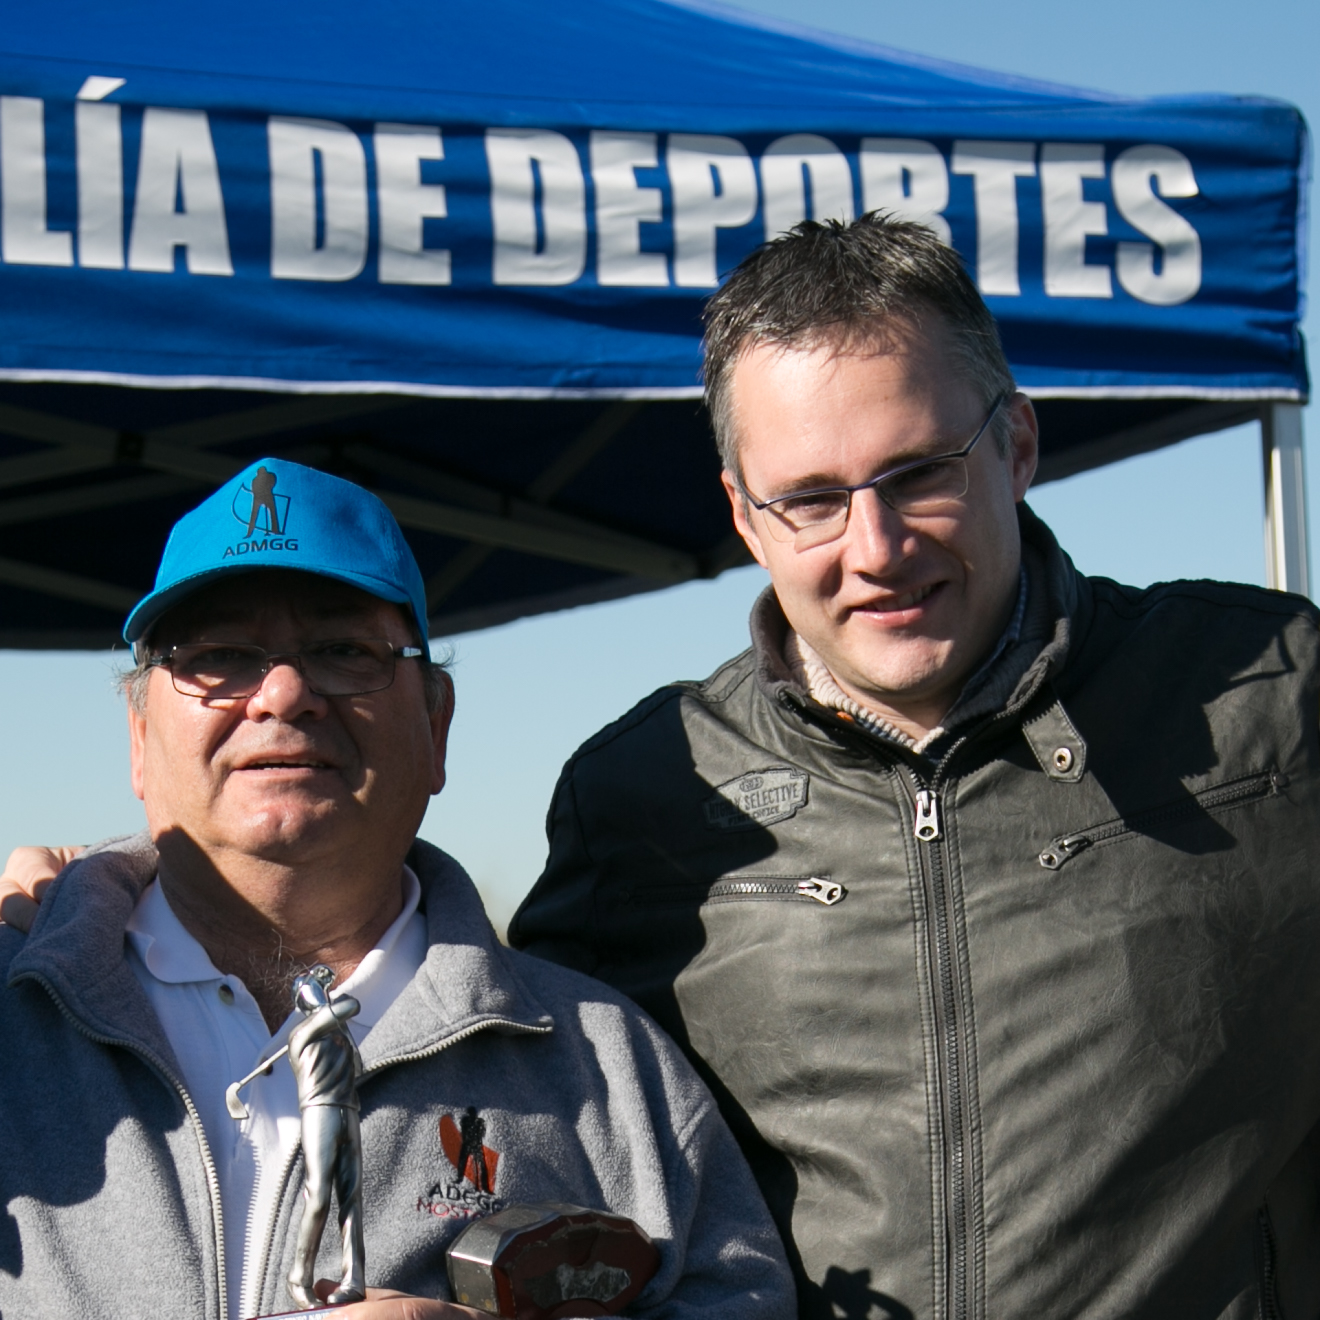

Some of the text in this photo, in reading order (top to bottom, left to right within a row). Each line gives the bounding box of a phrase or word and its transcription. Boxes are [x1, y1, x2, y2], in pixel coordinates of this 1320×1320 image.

[266, 115, 452, 285] DE
[484, 127, 1201, 306] DEPORTES
[222, 538, 298, 559] ADMGG
[744, 782, 799, 811] SELECTIVE
